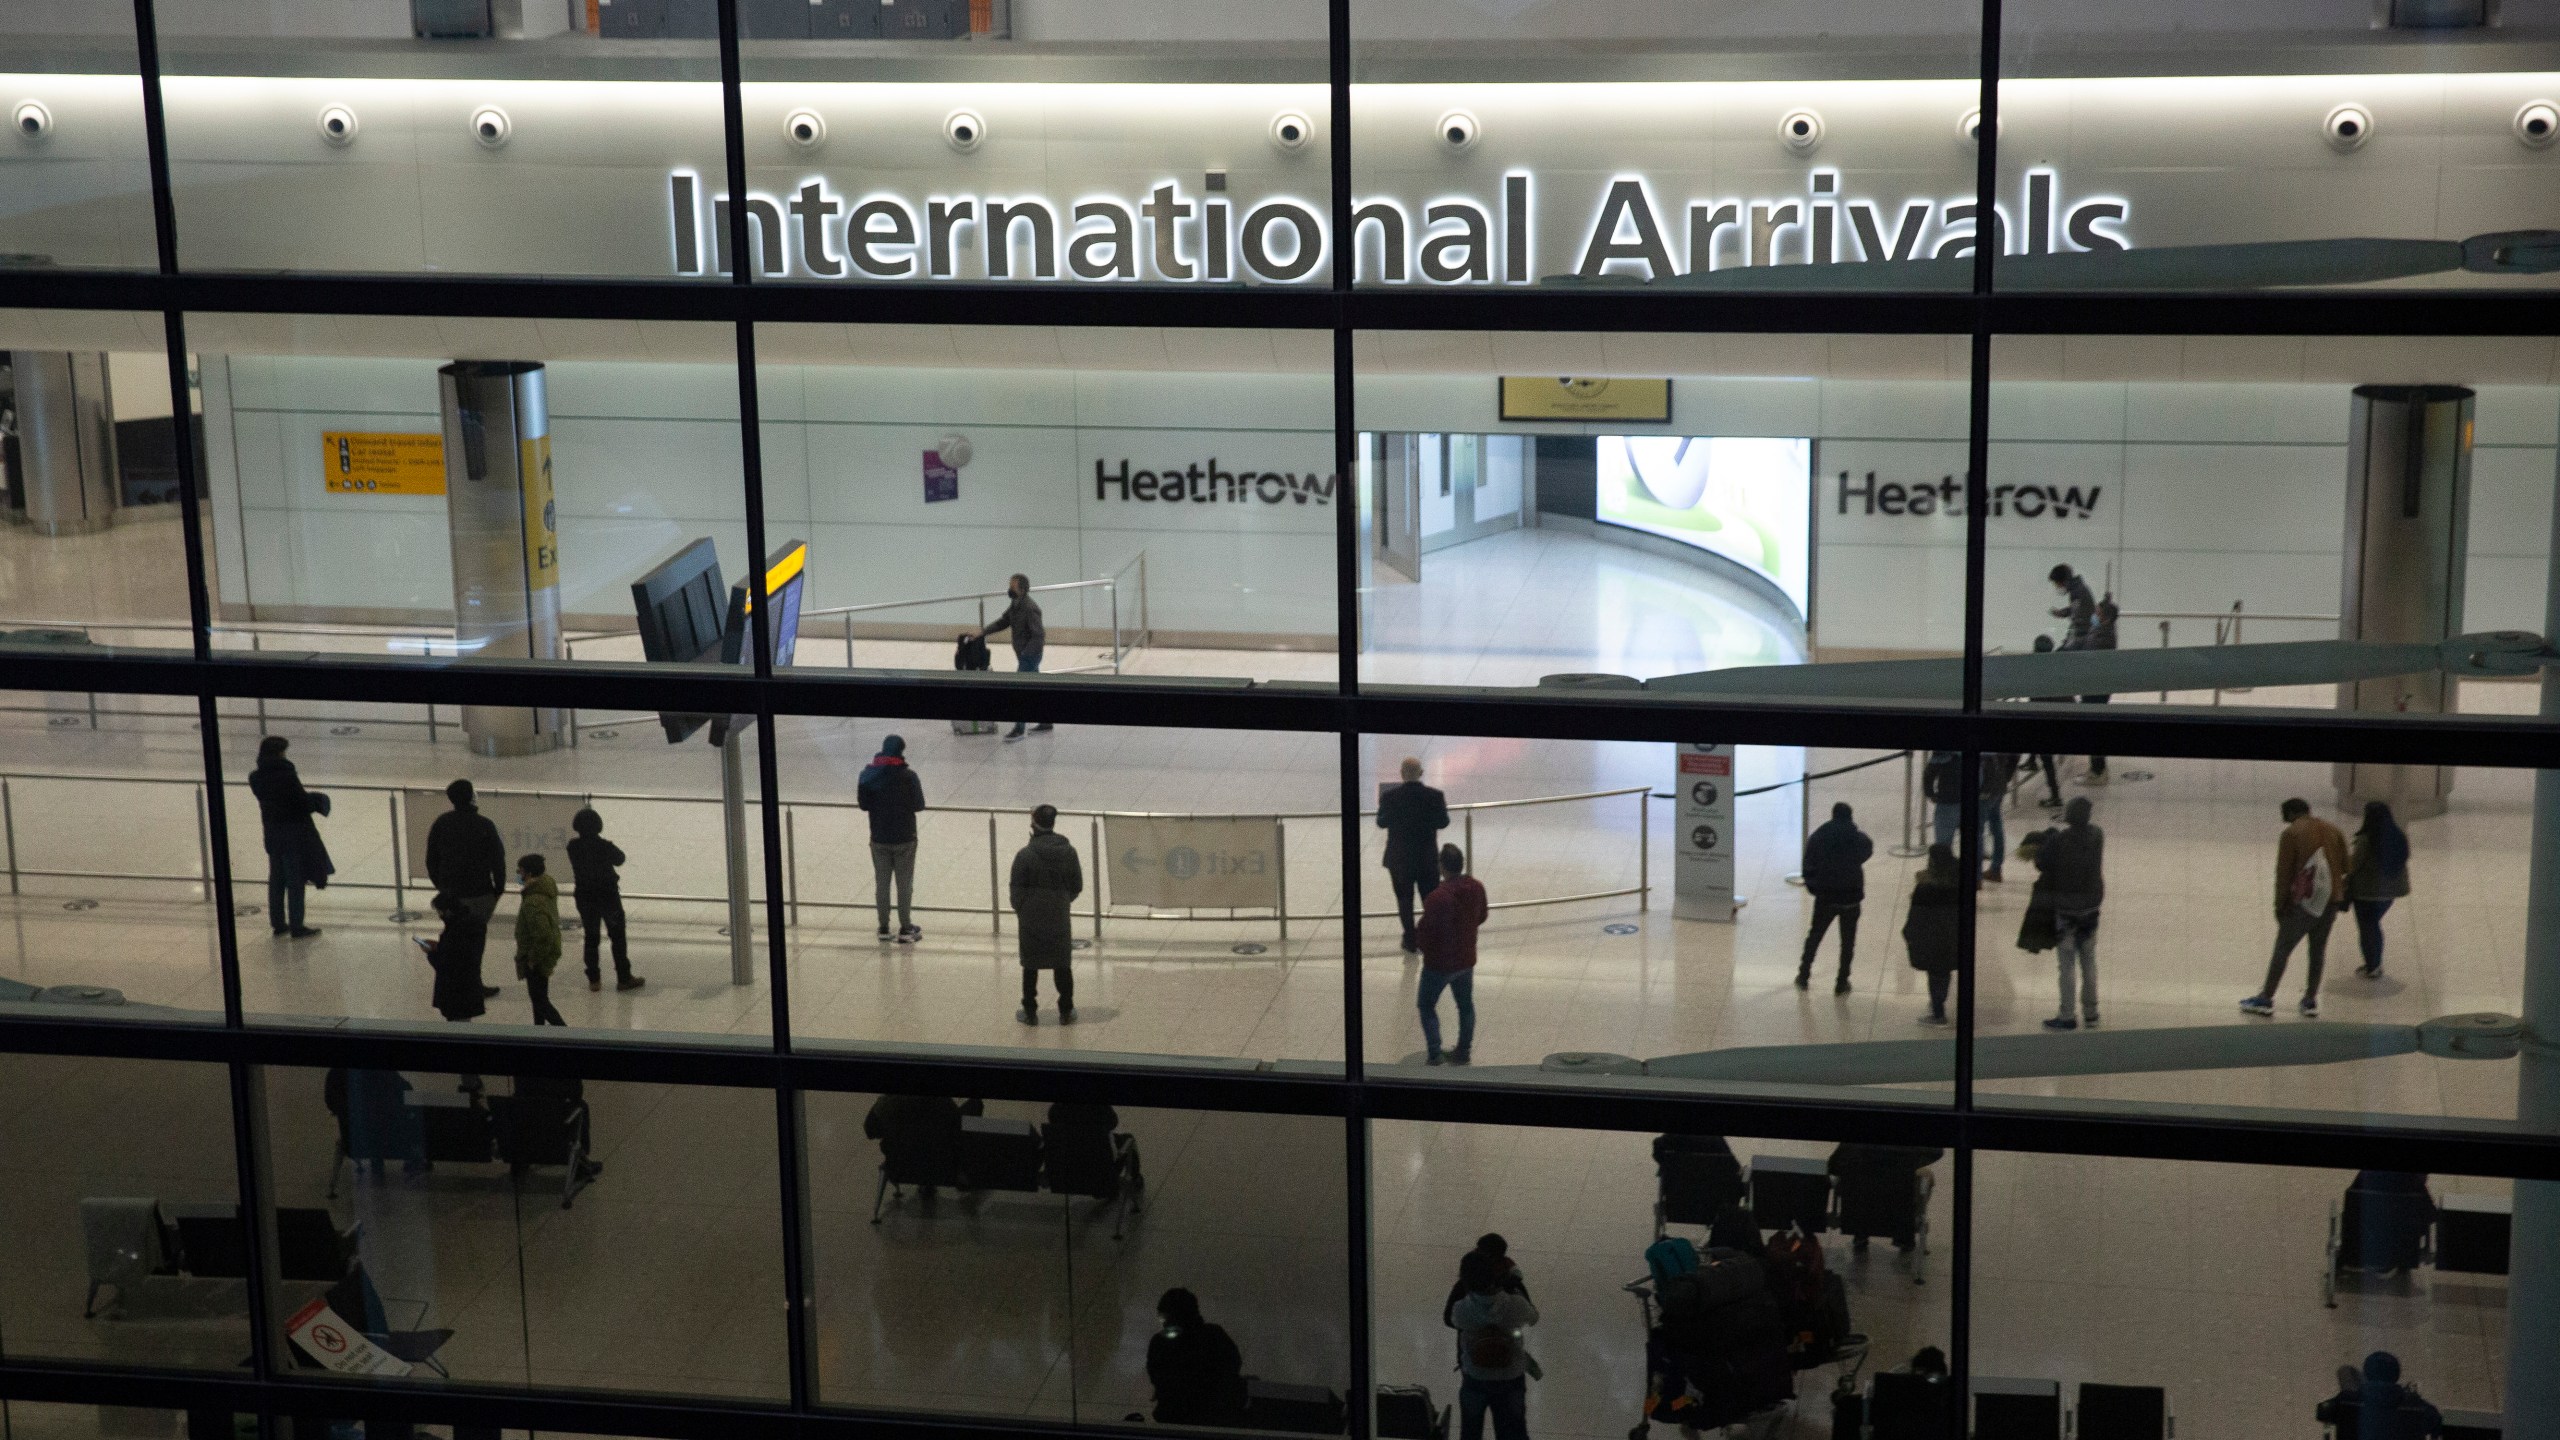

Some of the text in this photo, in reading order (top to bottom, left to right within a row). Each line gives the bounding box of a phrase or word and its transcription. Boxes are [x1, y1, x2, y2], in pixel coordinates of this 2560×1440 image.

[671, 172, 1533, 283] International
[1095, 457, 1336, 505] Heathrow
[1838, 470, 2101, 519] Heatrow
